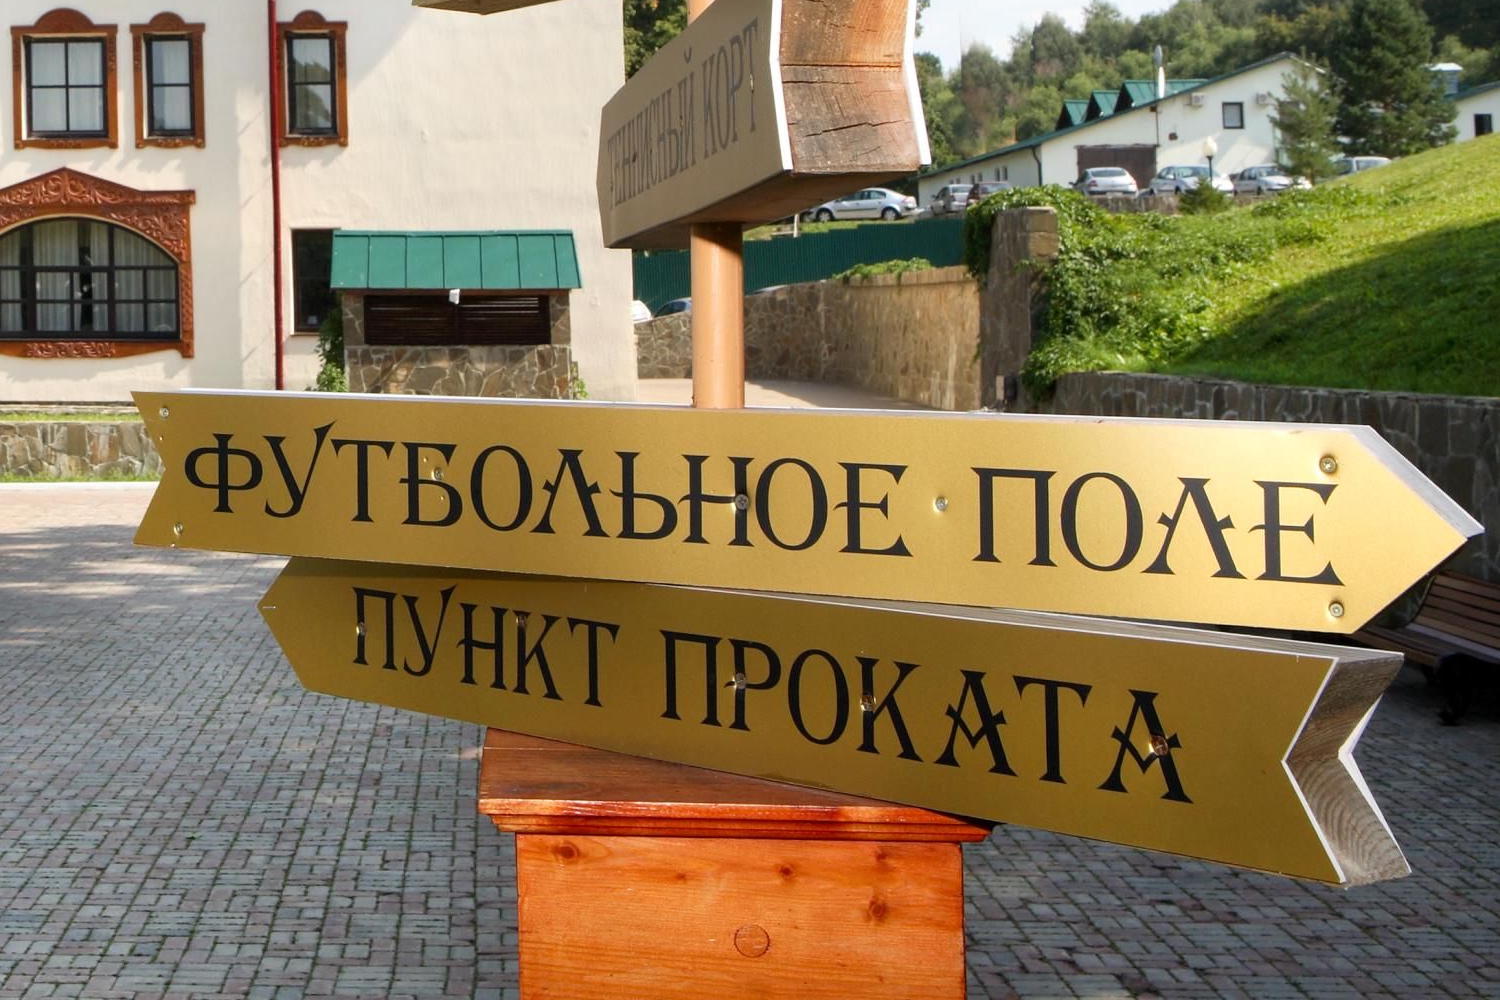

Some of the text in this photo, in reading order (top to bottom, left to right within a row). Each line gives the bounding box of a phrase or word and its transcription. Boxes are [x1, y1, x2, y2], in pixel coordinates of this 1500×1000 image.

[702, 17, 759, 160] КОРТ
[184, 420, 1345, 586] ФУТБОЛЬНОЕ ПОЛЕ
[352, 584, 1194, 804] ПУНКТ ПРОКАТА
